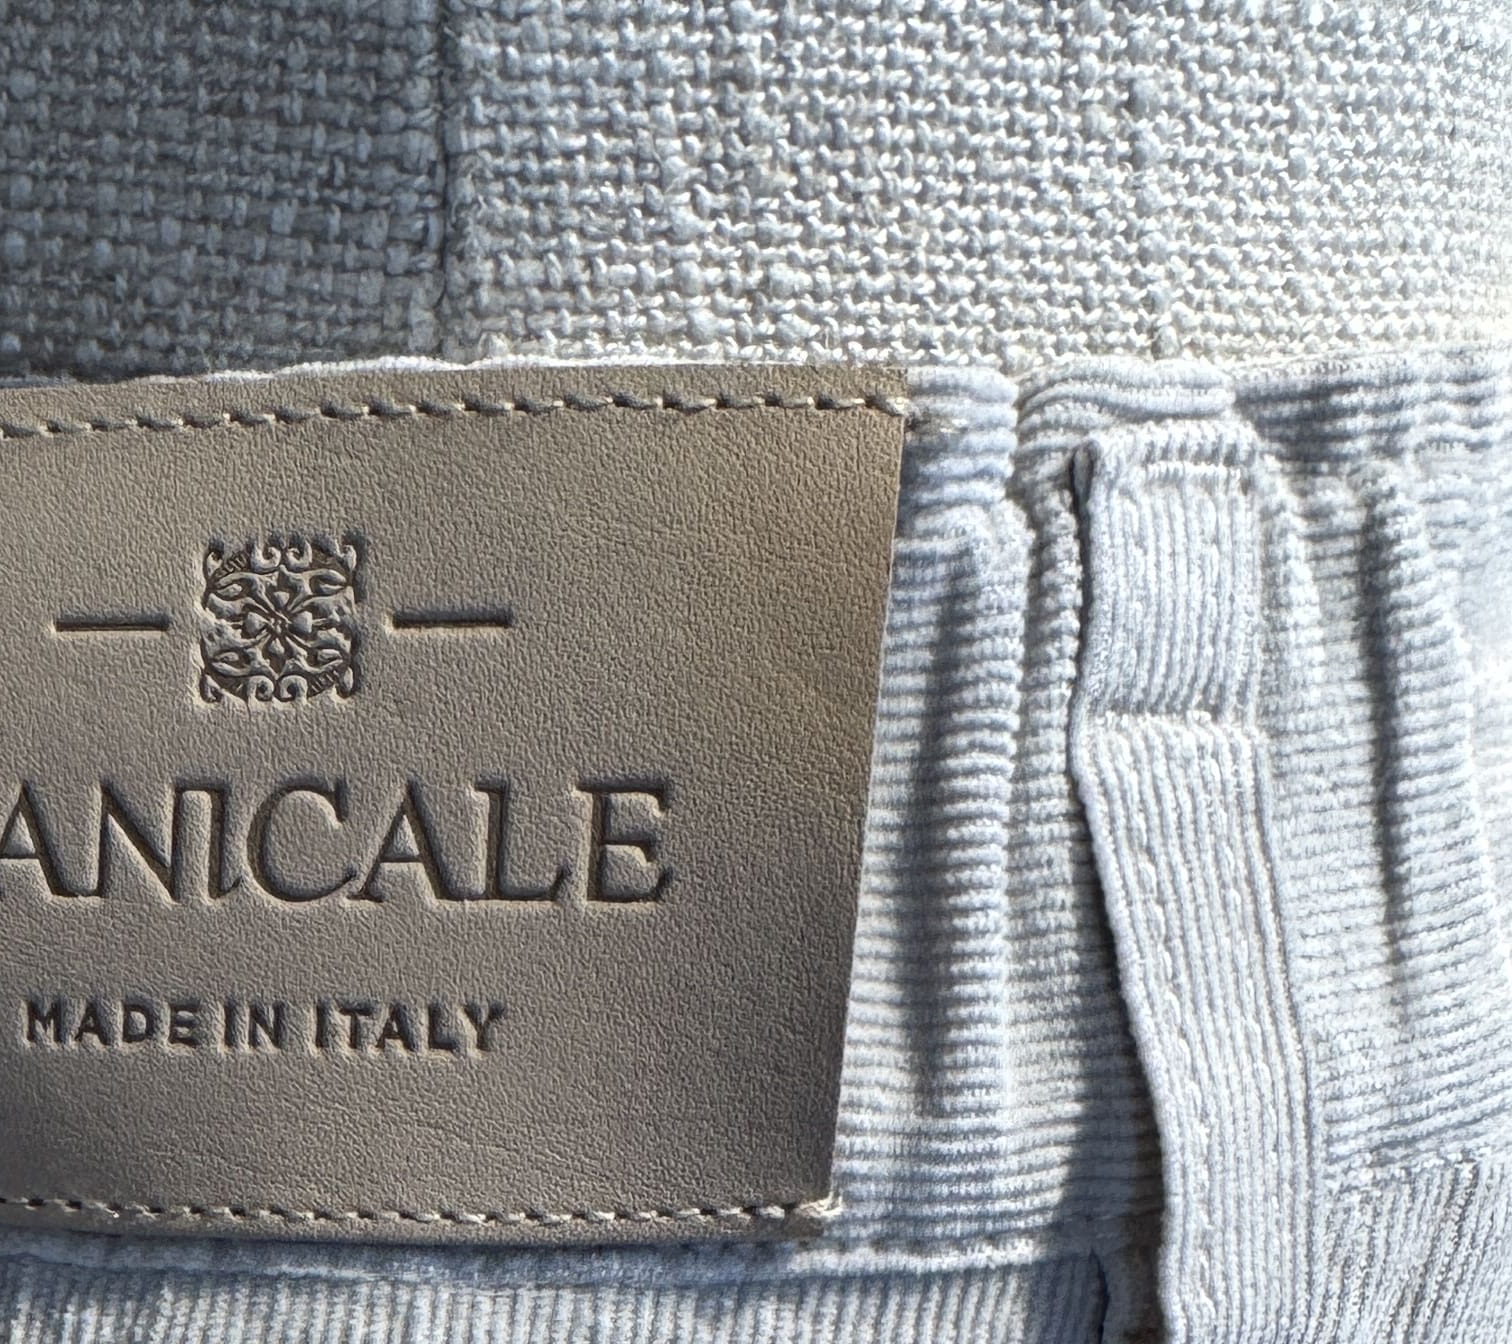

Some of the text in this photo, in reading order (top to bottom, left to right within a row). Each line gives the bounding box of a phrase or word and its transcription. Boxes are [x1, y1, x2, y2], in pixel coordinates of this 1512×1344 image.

[23, 997, 506, 1052] MADE IN ITALY
